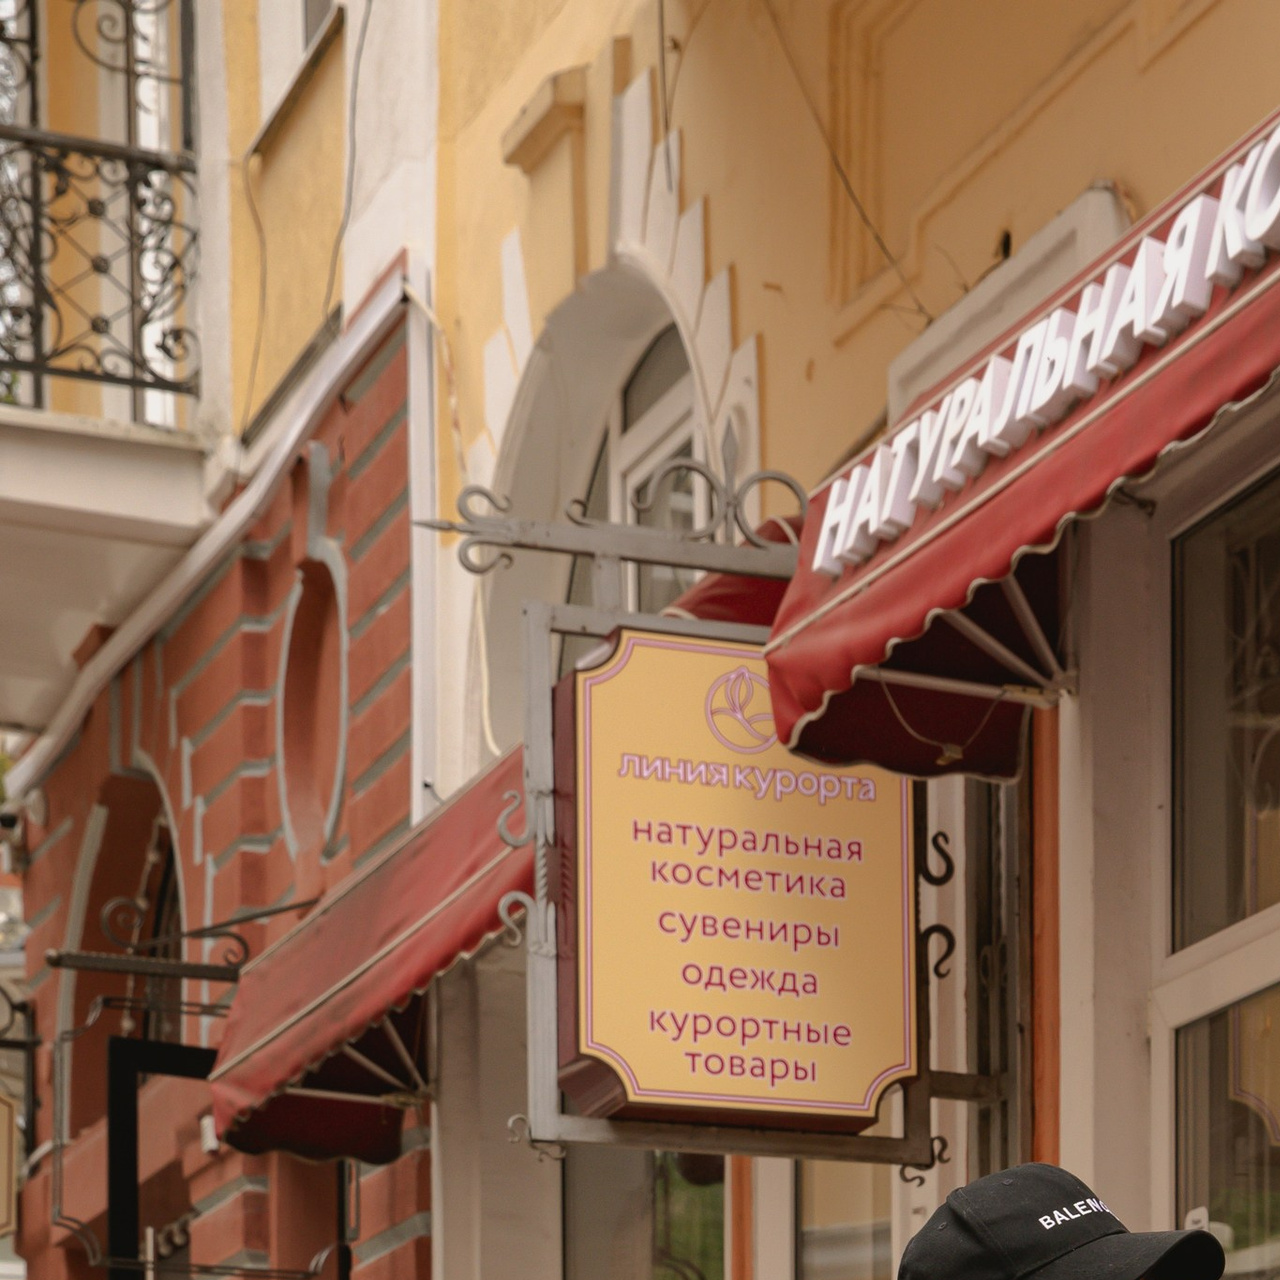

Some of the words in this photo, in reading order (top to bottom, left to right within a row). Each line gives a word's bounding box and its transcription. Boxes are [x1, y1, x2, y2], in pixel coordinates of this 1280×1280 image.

[811, 193, 1213, 578] НАТУРАЛЬНАЯ
[618, 753, 729, 788] линия
[734, 764, 876, 805] курорта
[632, 819, 863, 862] натуральная
[651, 860, 846, 899] косметика
[658, 911, 839, 951] сувениры
[681, 964, 818, 997] одежда
[650, 1010, 851, 1046] курортные
[684, 1052, 816, 1087] товары
